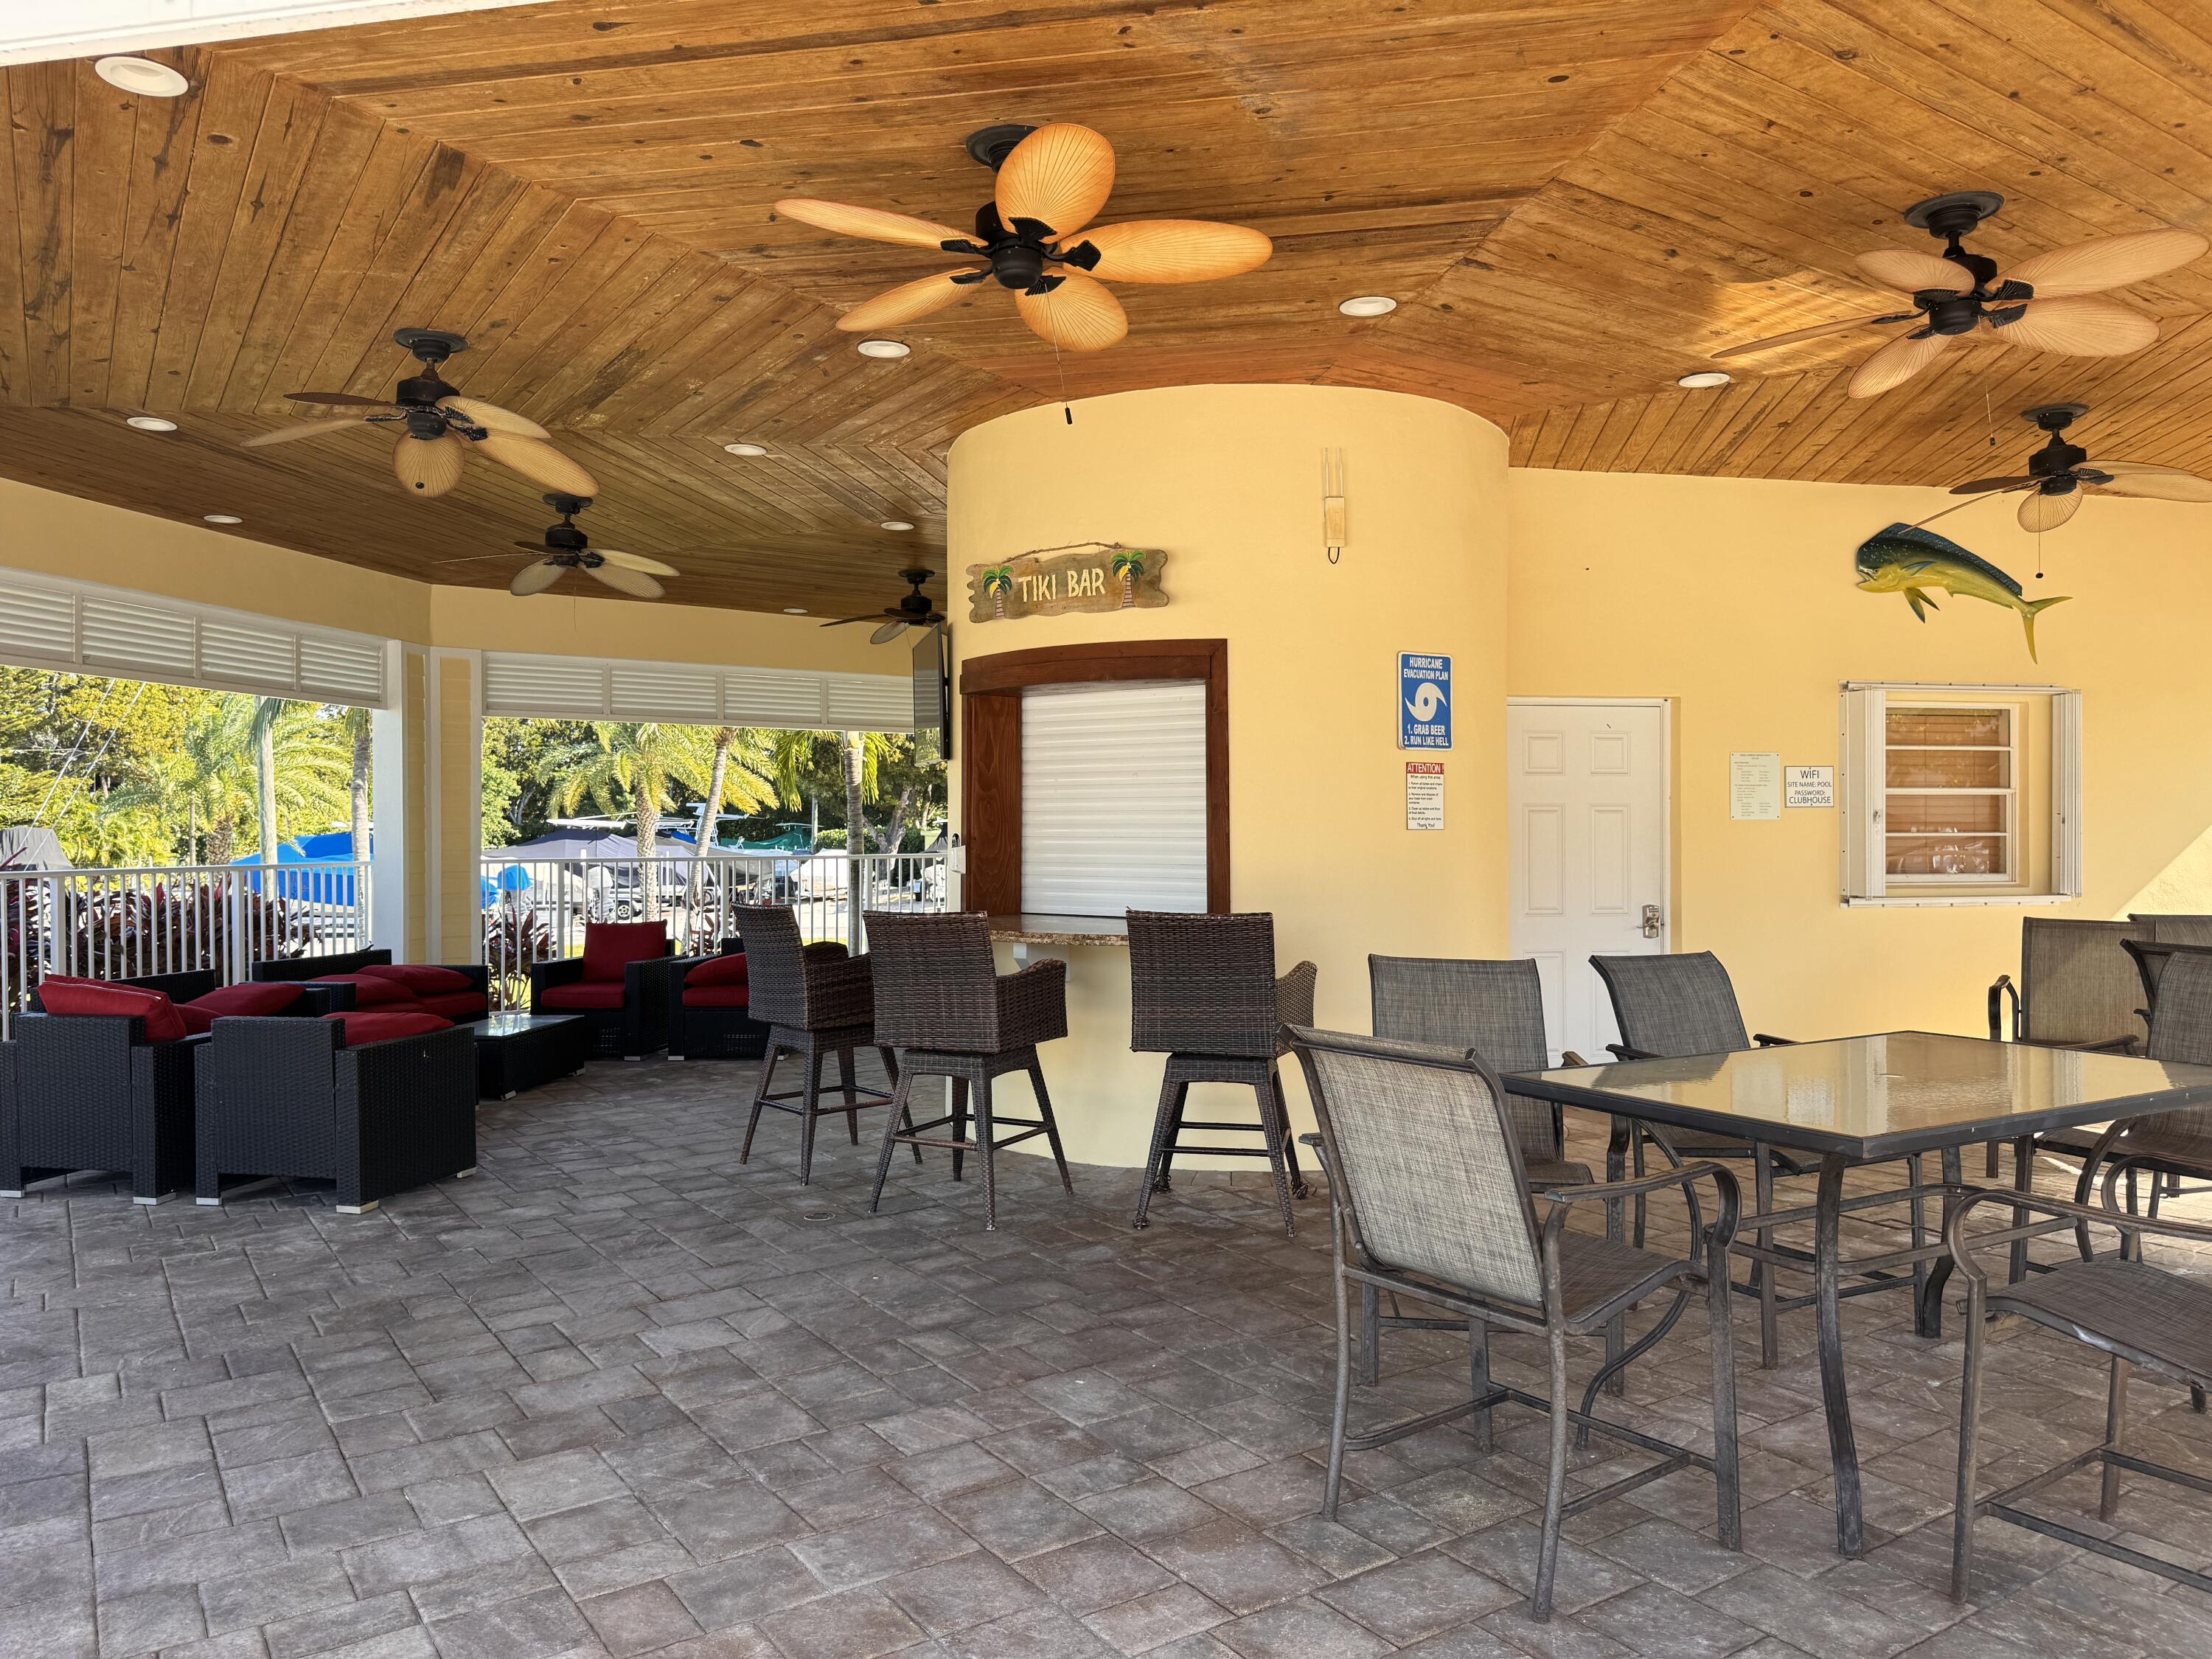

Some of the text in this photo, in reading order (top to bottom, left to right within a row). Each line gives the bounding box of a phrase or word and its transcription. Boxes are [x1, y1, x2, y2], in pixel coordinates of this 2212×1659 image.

[1018, 568, 1105, 602] TIKI BAR
[1409, 657, 1443, 669] HURRICANE
[1403, 669, 1448, 680] EVACUATION PLAN
[1407, 723, 1445, 736] 1. GRAB BEER
[1404, 736, 1449, 746] 2. RUN LIKE HELL
[1408, 763, 1441, 773] ATTENTION
